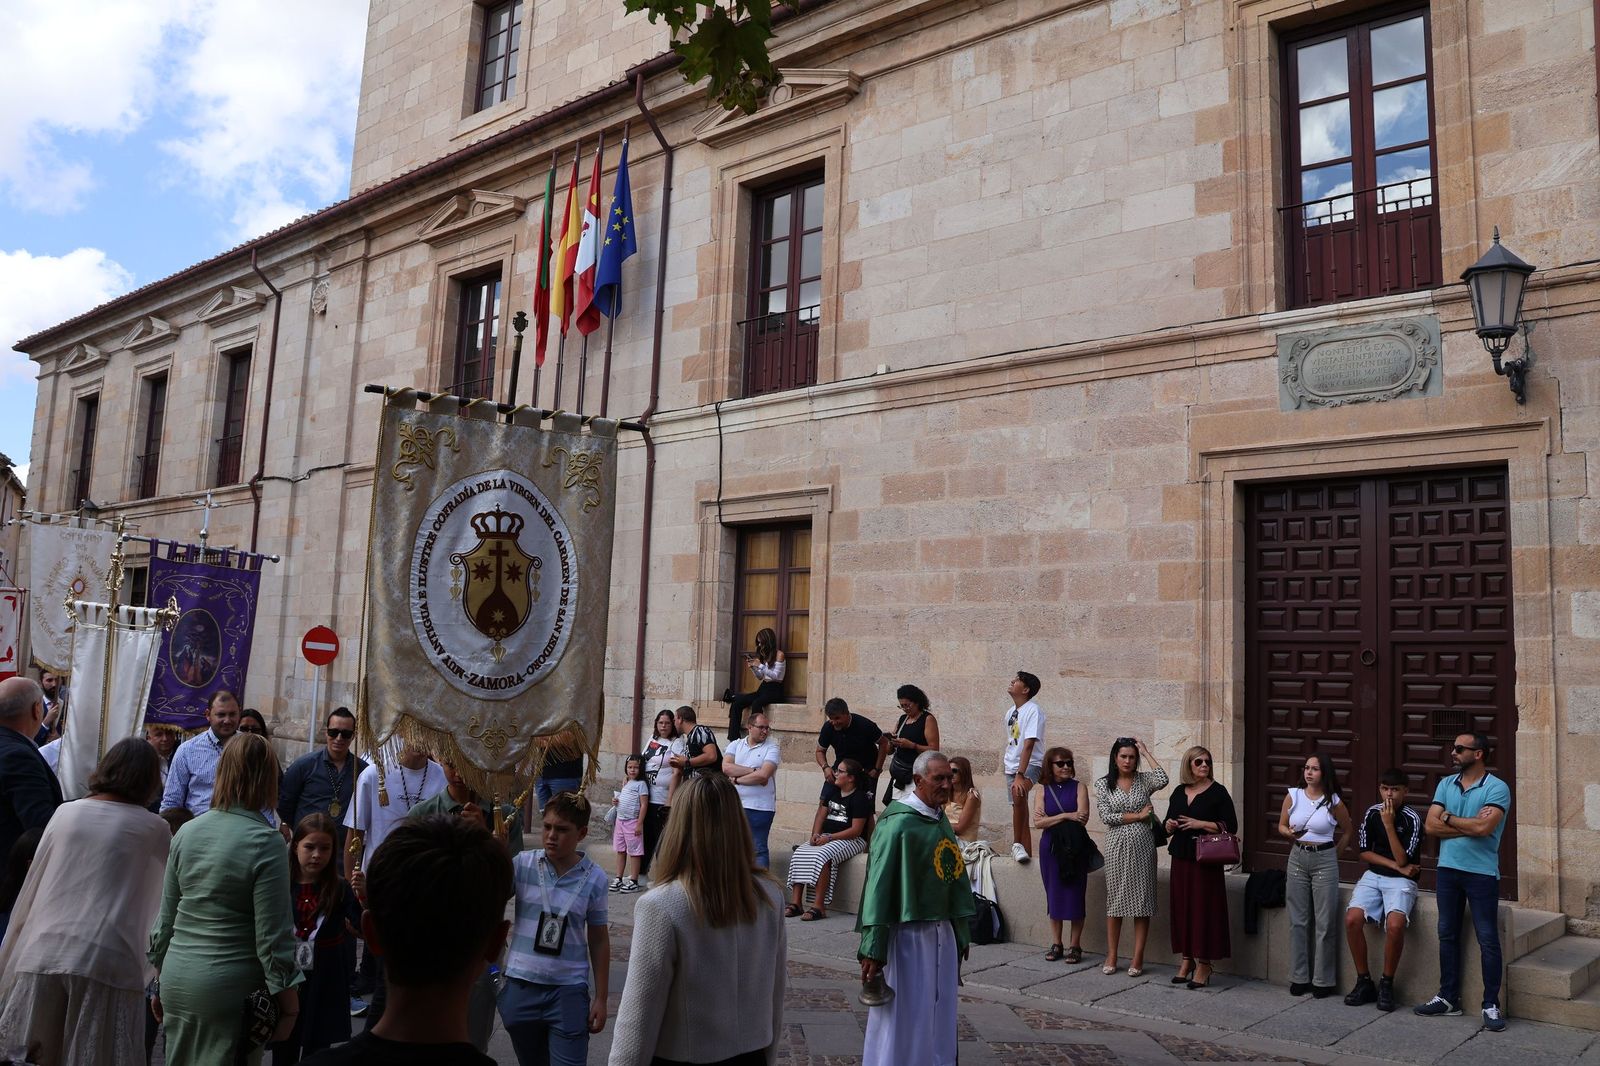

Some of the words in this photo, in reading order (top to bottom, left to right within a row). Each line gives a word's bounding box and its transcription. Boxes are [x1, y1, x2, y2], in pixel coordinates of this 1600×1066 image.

[476, 480, 492, 494] DE
[492, 478, 508, 490] LA
[508, 480, 542, 510] VIRGEN
[432, 486, 476, 532] COFRADÍA
[538, 505, 556, 532] DEL
[418, 531, 438, 588] ILUSTRE
[553, 530, 570, 584] CARMEN
[418, 590, 427, 600] E
[560, 587, 570, 606] DE
[420, 600, 446, 656] ANTIGUA
[553, 608, 566, 634] SAN
[442, 655, 466, 679] MUY
